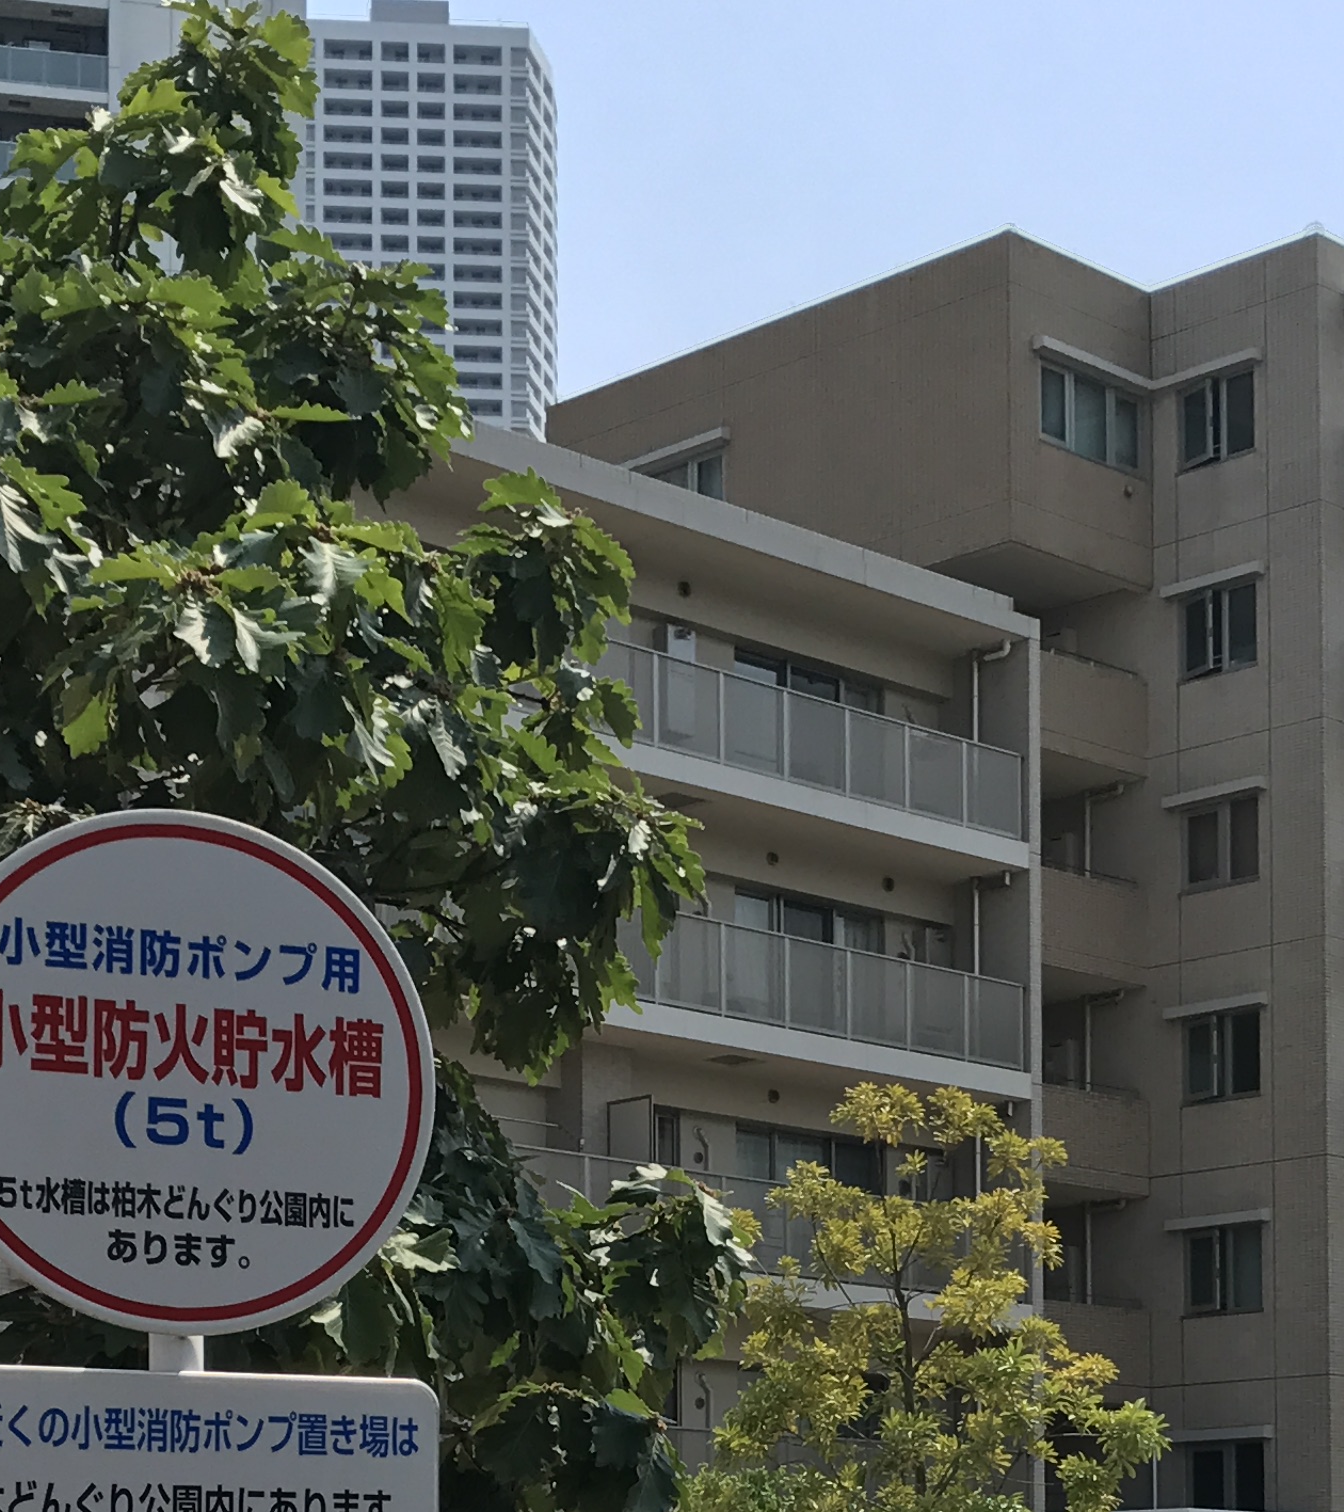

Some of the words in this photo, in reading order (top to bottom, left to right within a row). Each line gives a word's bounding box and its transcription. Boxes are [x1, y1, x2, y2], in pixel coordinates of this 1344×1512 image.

[114, 1091, 254, 1155] (5t)
[107, 1230, 251, 1269] あります。
